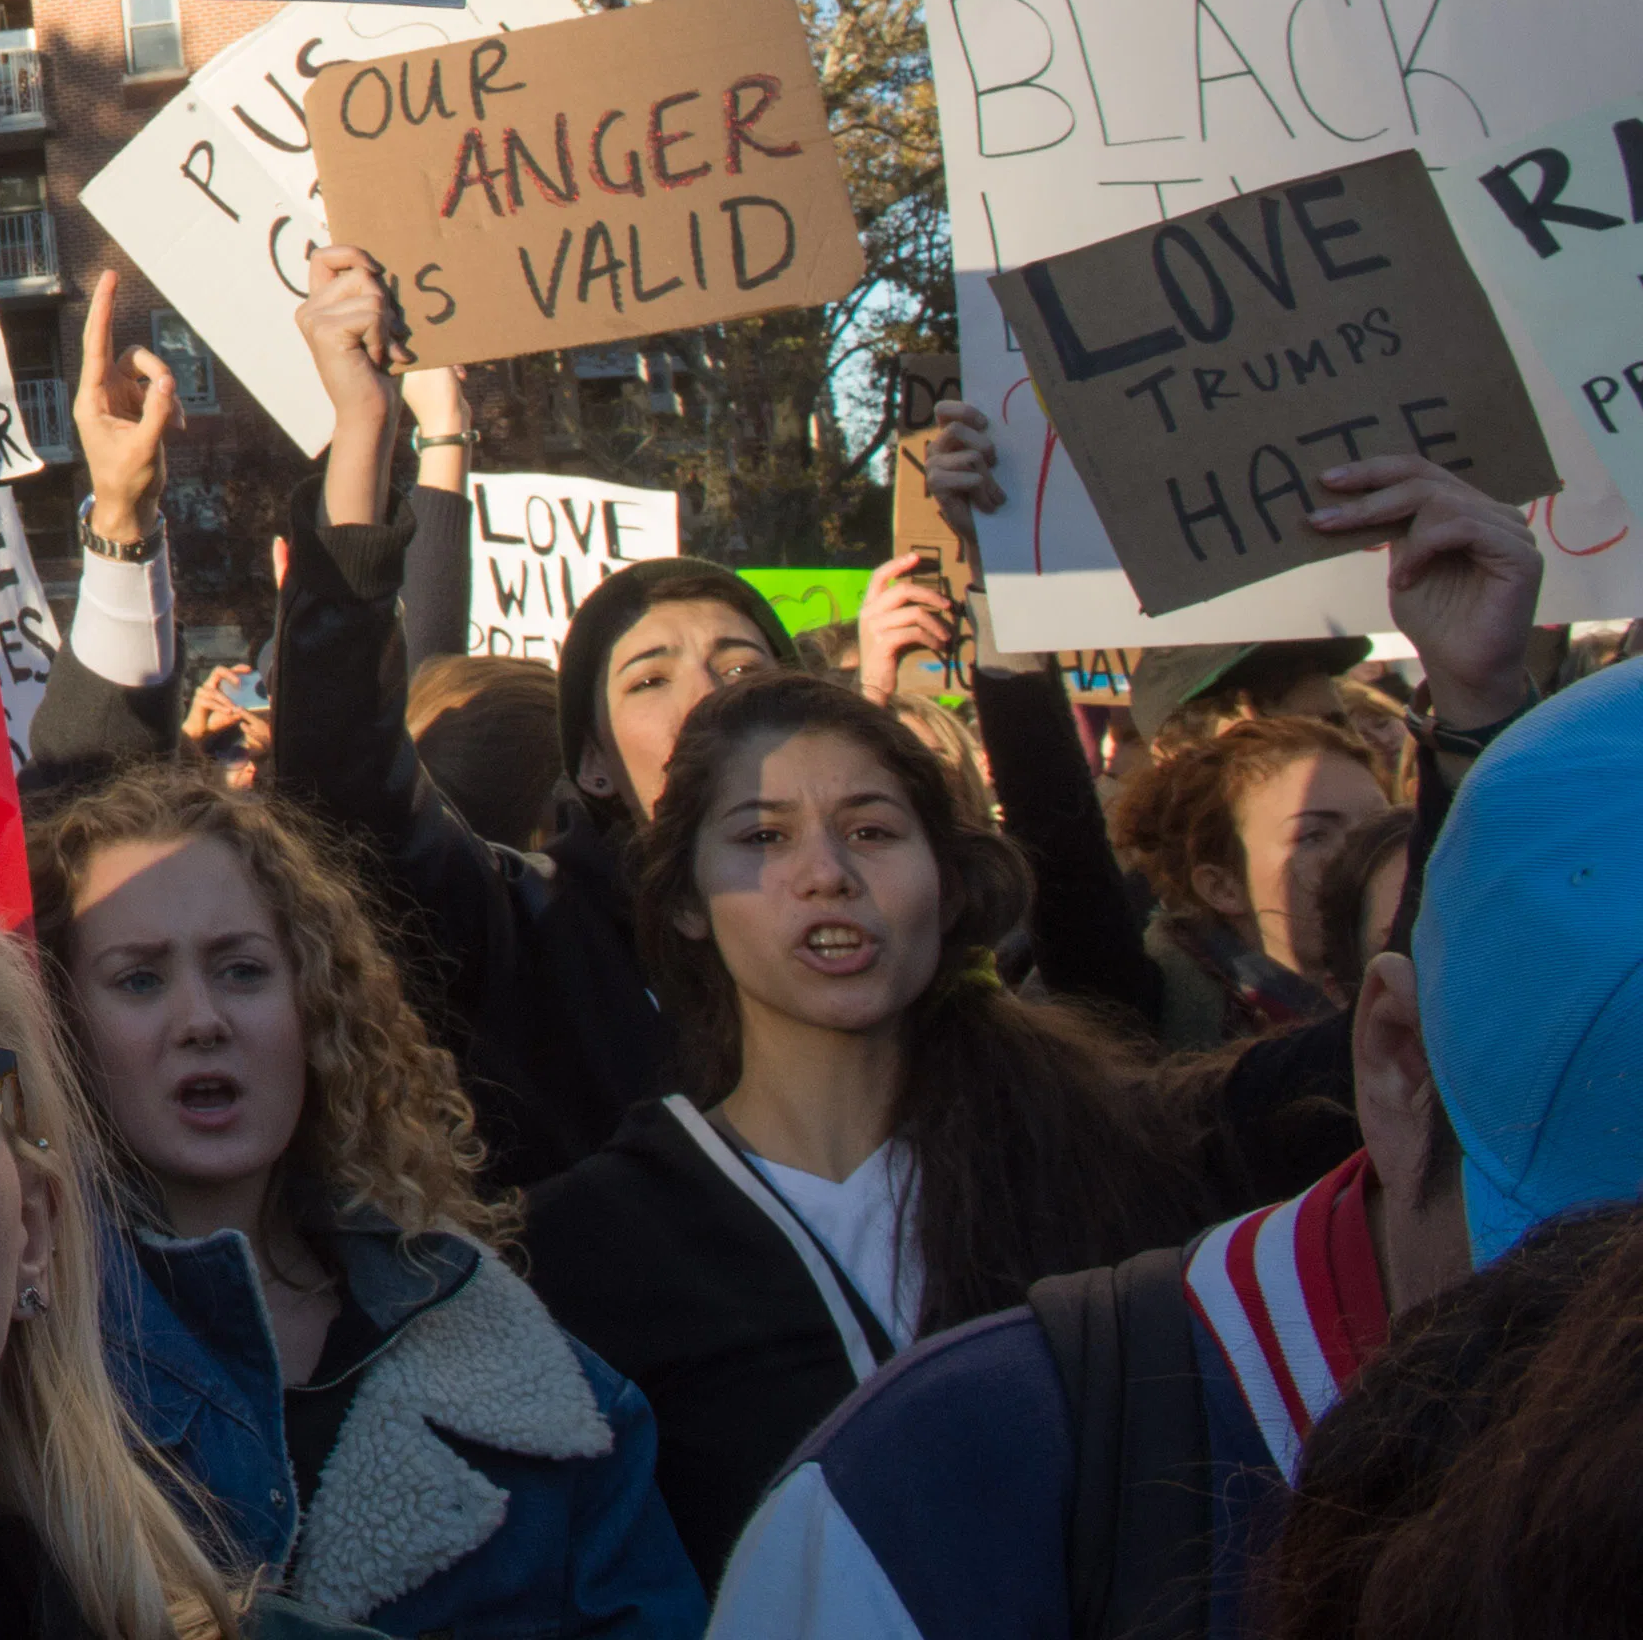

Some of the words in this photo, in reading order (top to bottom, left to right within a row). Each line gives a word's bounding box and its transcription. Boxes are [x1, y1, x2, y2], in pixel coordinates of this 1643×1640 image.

[339, 38, 527, 140] OUR
[439, 72, 804, 218] ANGER
[518, 195, 797, 319] VALID
[1021, 175, 1392, 382] LOVE
[1123, 306, 1403, 433] TRUMPS
[474, 482, 645, 562] LOVE
